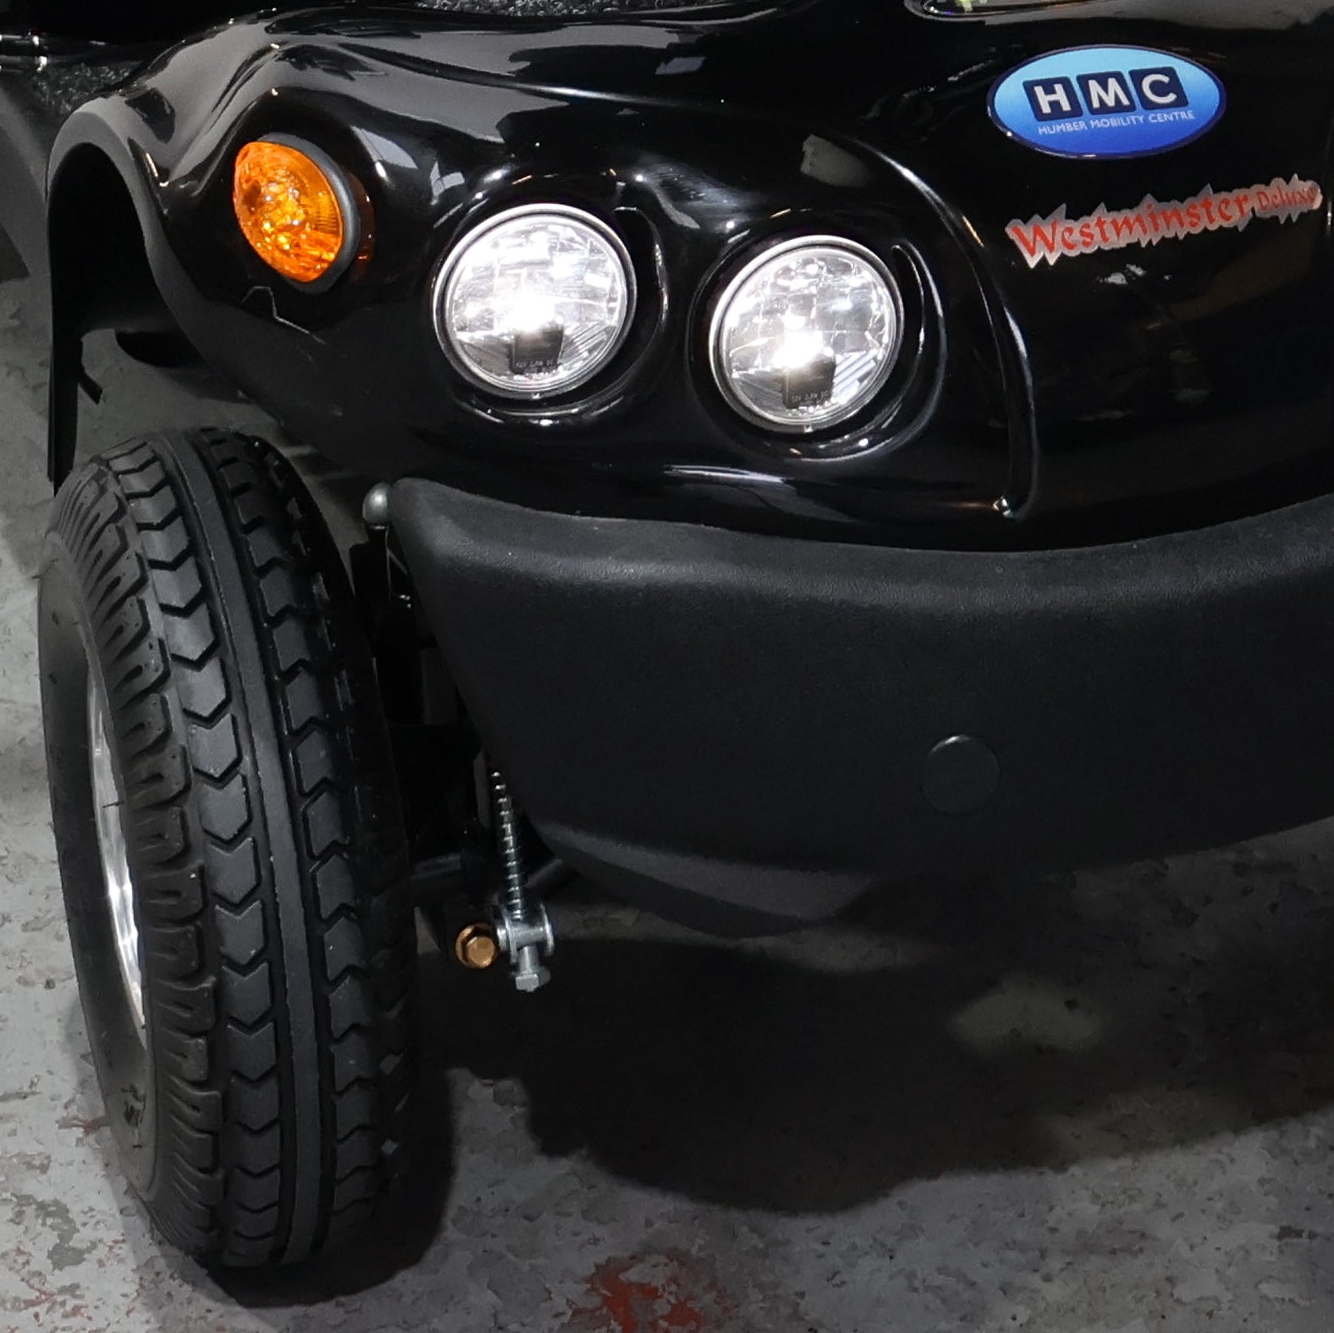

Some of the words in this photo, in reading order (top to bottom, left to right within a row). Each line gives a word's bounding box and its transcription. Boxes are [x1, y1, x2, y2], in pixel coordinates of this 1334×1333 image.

[1033, 73, 1178, 114] HMC
[1038, 120, 1088, 135] HUMBER
[1090, 115, 1145, 130] MOBILITY
[1148, 110, 1195, 124] CENTRE
[1011, 194, 1250, 257] Westminster
[1255, 185, 1317, 211] Deluxe
